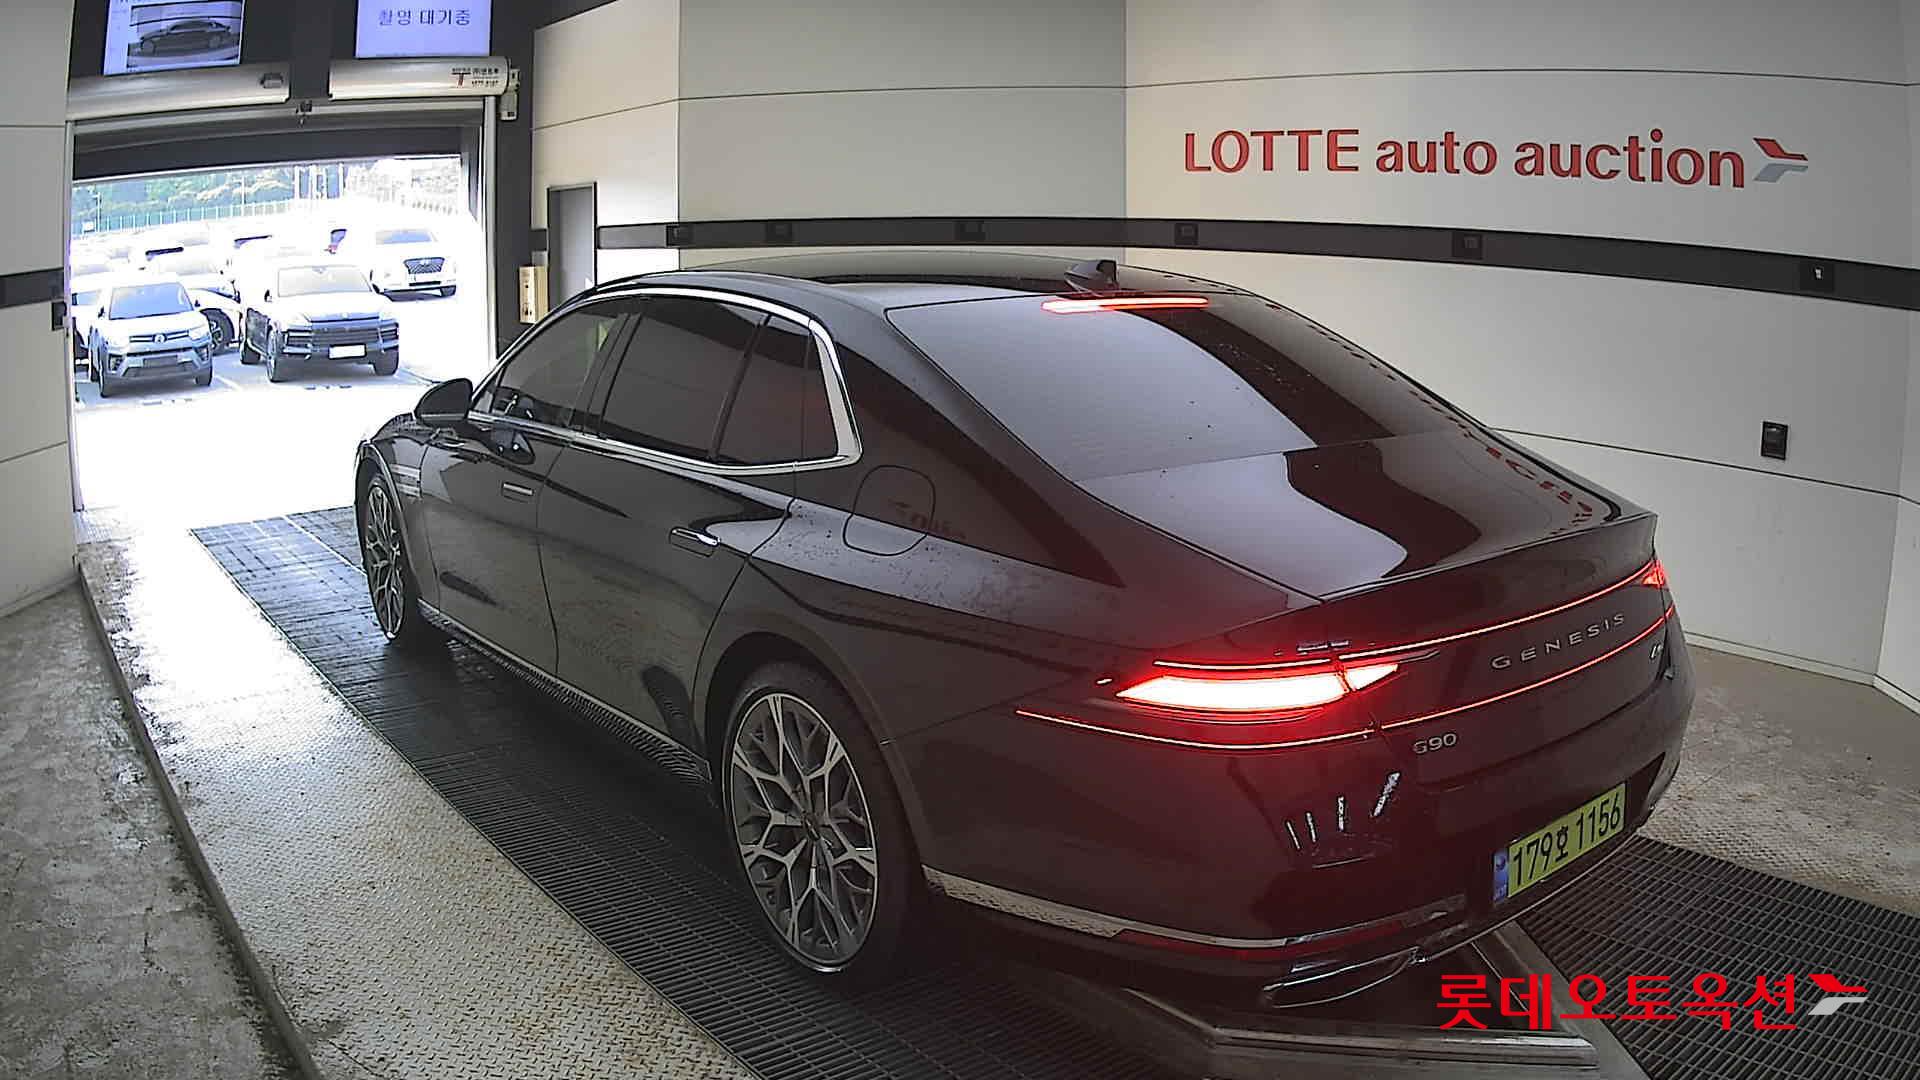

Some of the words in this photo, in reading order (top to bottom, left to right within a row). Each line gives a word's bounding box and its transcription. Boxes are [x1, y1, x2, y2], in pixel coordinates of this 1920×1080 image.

[420, 8, 470, 26] 대기중
[1184, 129, 1359, 172] LOTTE
[1376, 132, 1498, 174] auto
[1514, 129, 1745, 188] auction
[1491, 613, 1625, 670] GENESIS
[1412, 732, 1458, 755] G90
[1513, 826, 1569, 887] 179호
[1575, 792, 1622, 850] 1156
